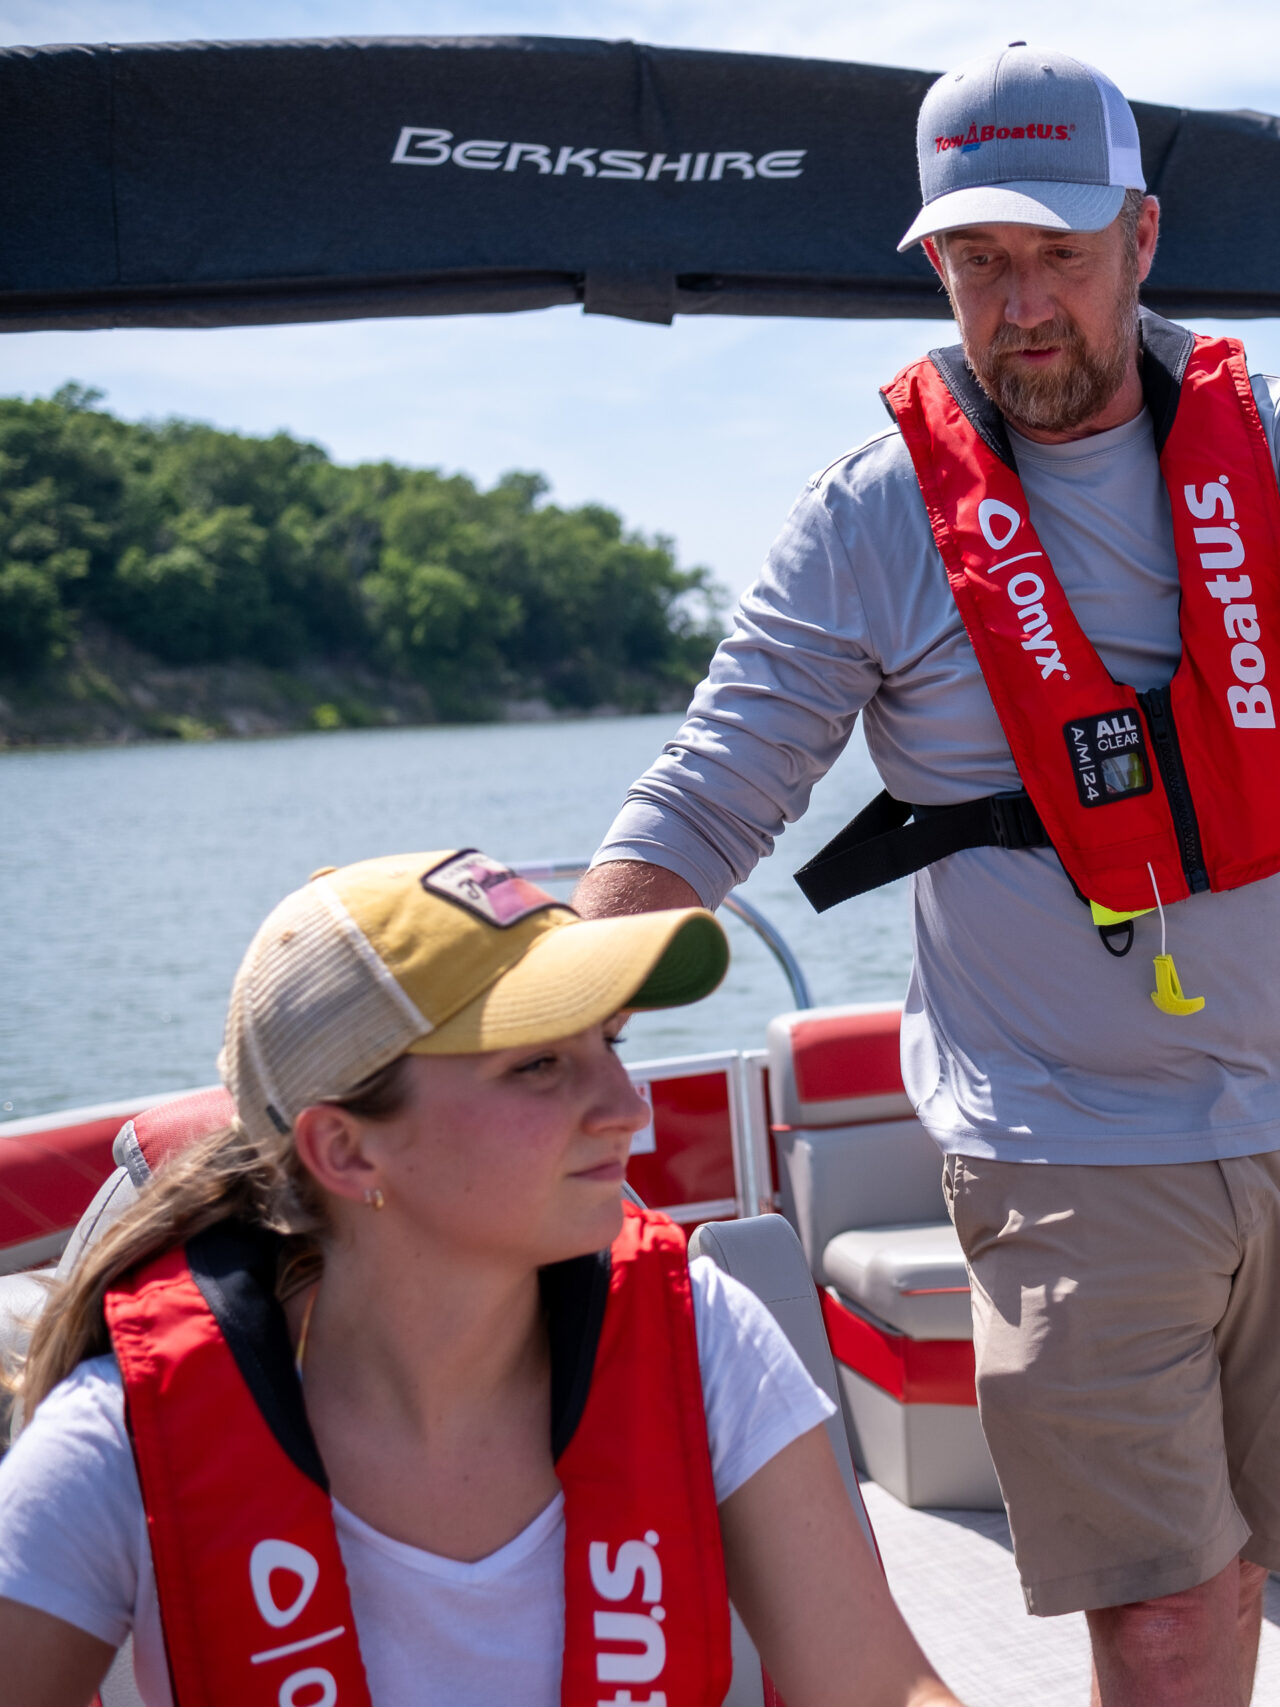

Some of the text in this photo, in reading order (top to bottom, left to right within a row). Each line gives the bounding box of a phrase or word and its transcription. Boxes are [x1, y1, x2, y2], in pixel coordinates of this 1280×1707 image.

[390, 126, 807, 182] BERKSHIRE
[1096, 715, 1137, 739] ALL
[1097, 732, 1139, 751] CLEAR
